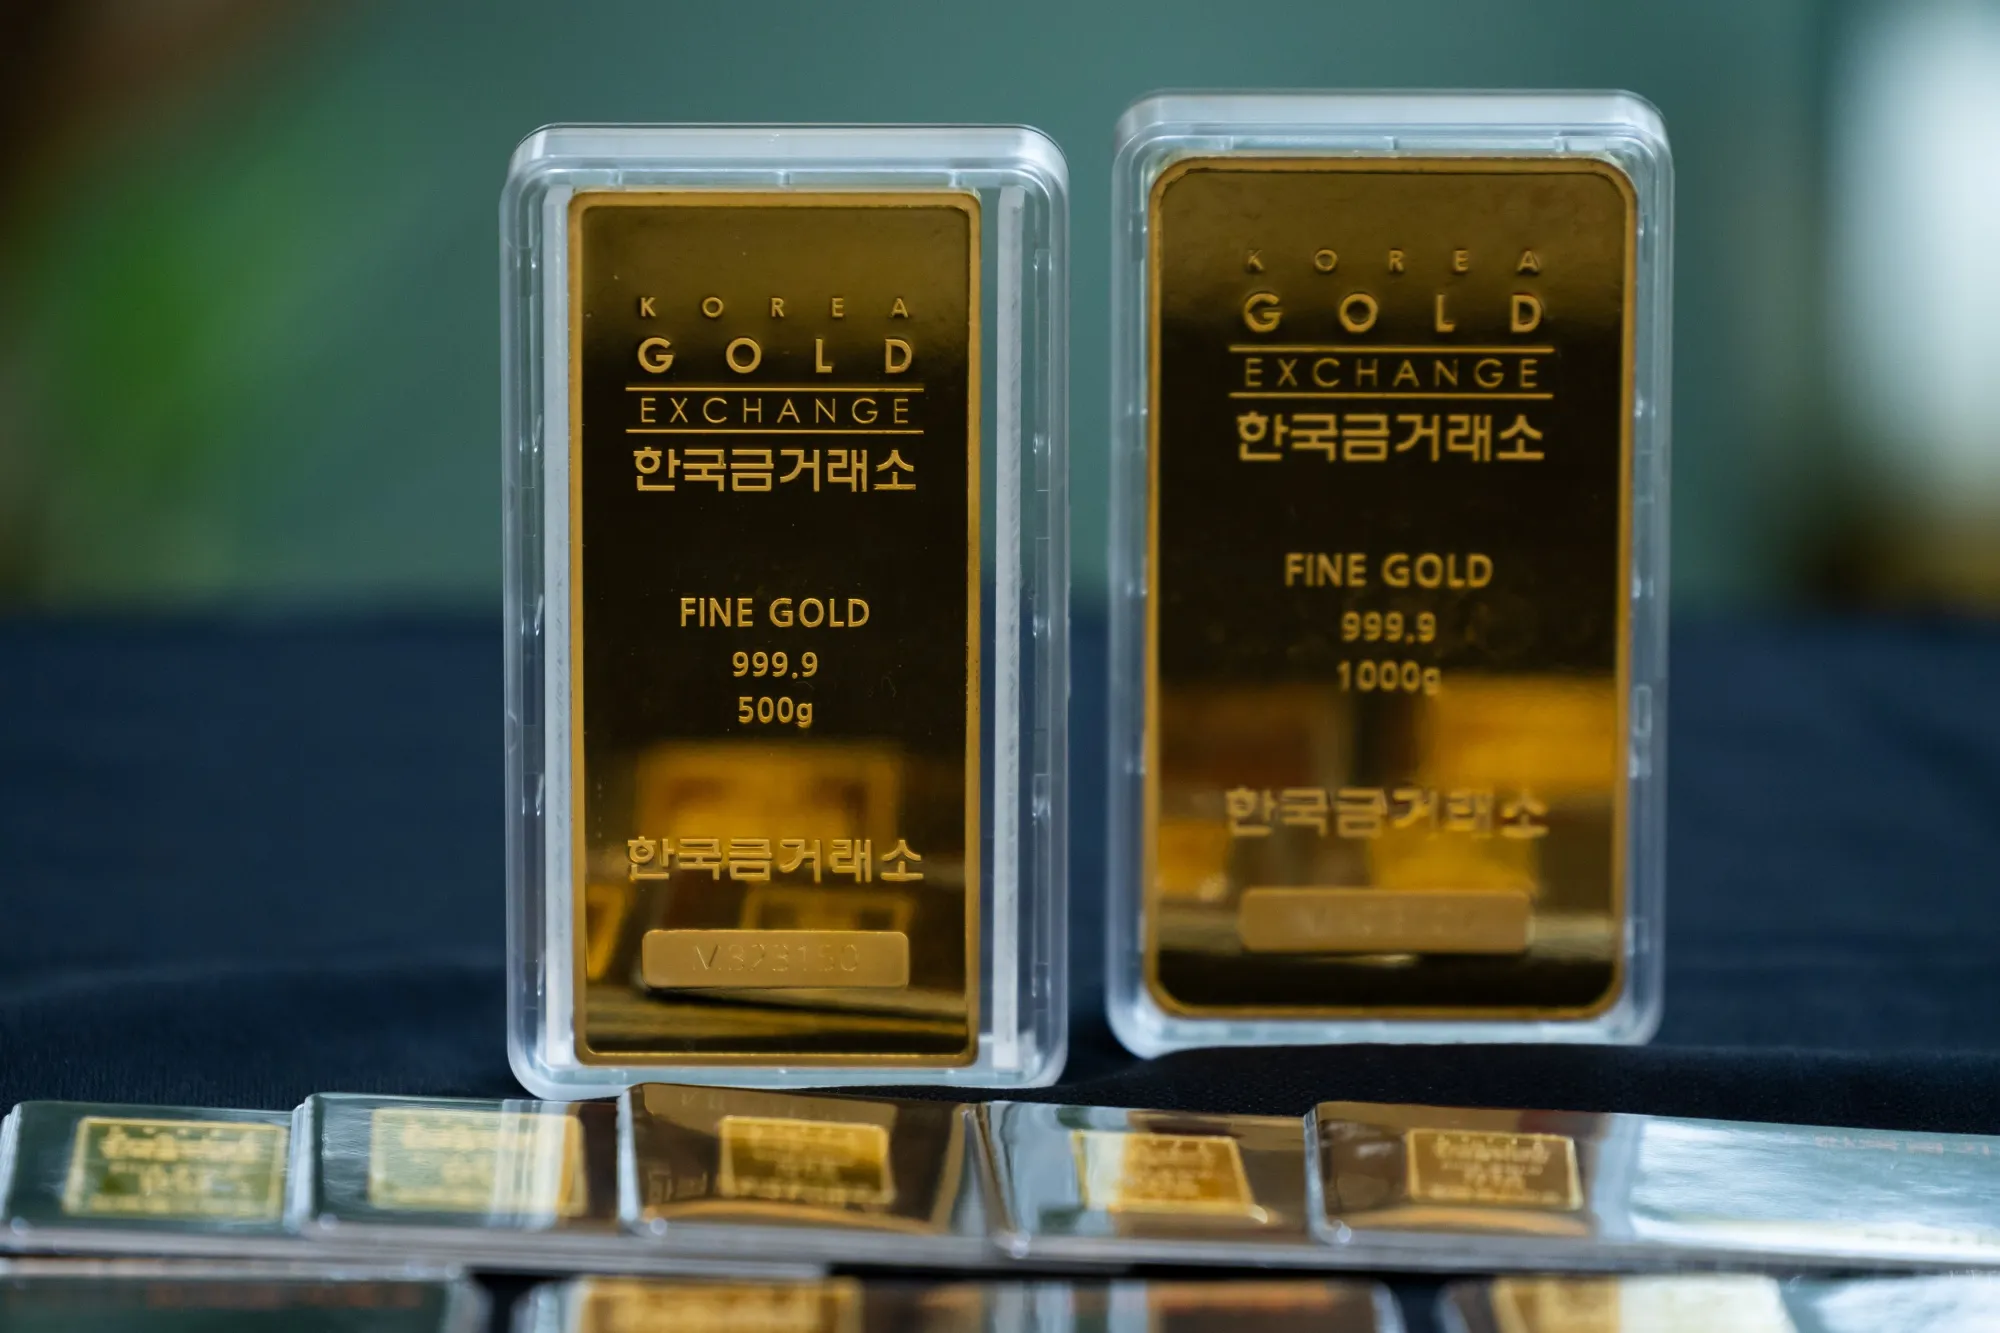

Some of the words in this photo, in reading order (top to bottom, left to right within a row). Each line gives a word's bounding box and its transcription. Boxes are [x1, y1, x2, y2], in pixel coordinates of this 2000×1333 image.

[1245, 249, 1541, 274] KOREA
[641, 296, 910, 318] KOREA
[1242, 292, 1544, 333] GOLD
[637, 336, 914, 374] GOLD
[1244, 357, 1539, 388] EXCHANGE
[640, 397, 910, 424] EXCHANGE
[1237, 411, 1545, 462] 한국금거래소
[633, 446, 917, 493] 한국금거래소
[1284, 552, 1367, 587] FINE
[1381, 552, 1493, 589] GOLD
[680, 597, 754, 628] FINE
[769, 597, 870, 628] GOLD
[1341, 610, 1437, 643] 999.9
[732, 651, 818, 680] 999.9
[1337, 659, 1442, 696] 1000g
[738, 696, 813, 729] 500g
[1225, 785, 1549, 839] 한국금거래소
[627, 835, 924, 883] 한국금거래소
